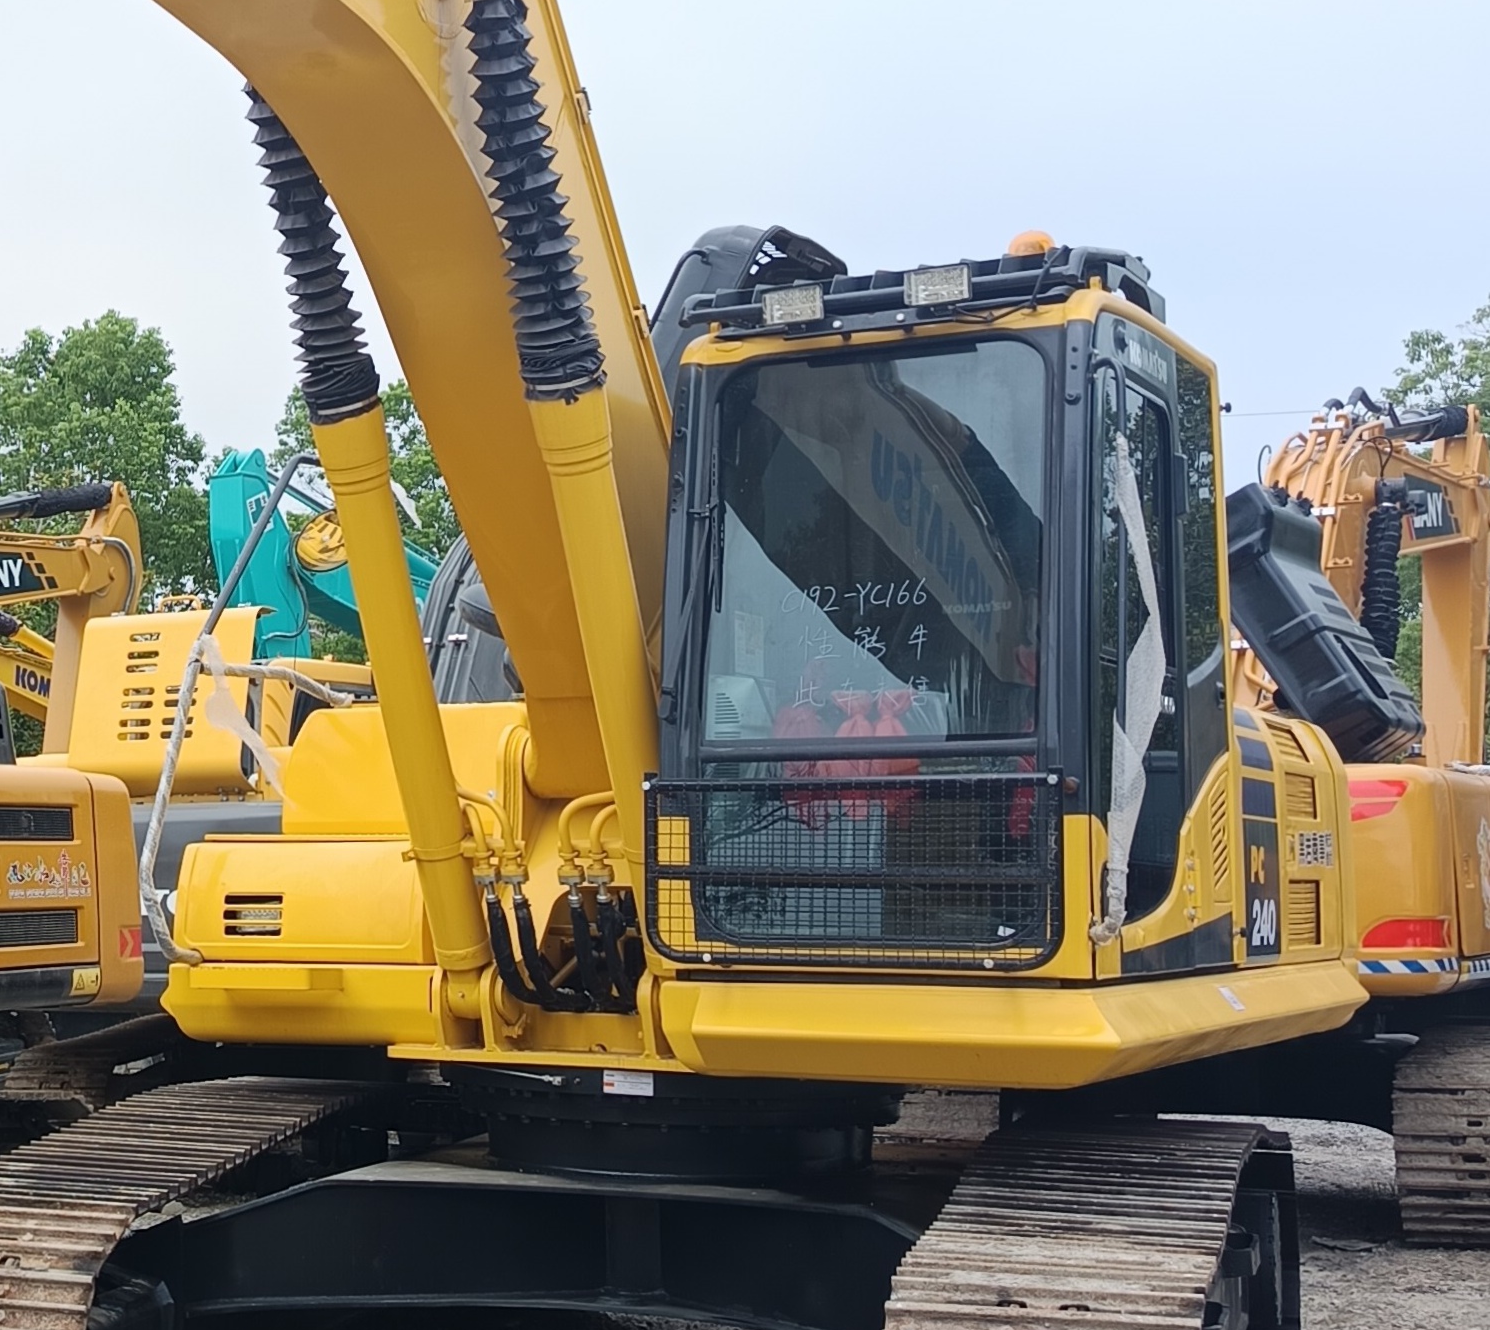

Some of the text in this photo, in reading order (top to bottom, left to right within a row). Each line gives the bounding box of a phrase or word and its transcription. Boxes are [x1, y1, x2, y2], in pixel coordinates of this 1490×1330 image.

[1128, 338, 1168, 385] KOMATSU
[942, 600, 1013, 615] KOMATSU
[1250, 845, 1265, 884] PC
[1251, 898, 1277, 946] 240
